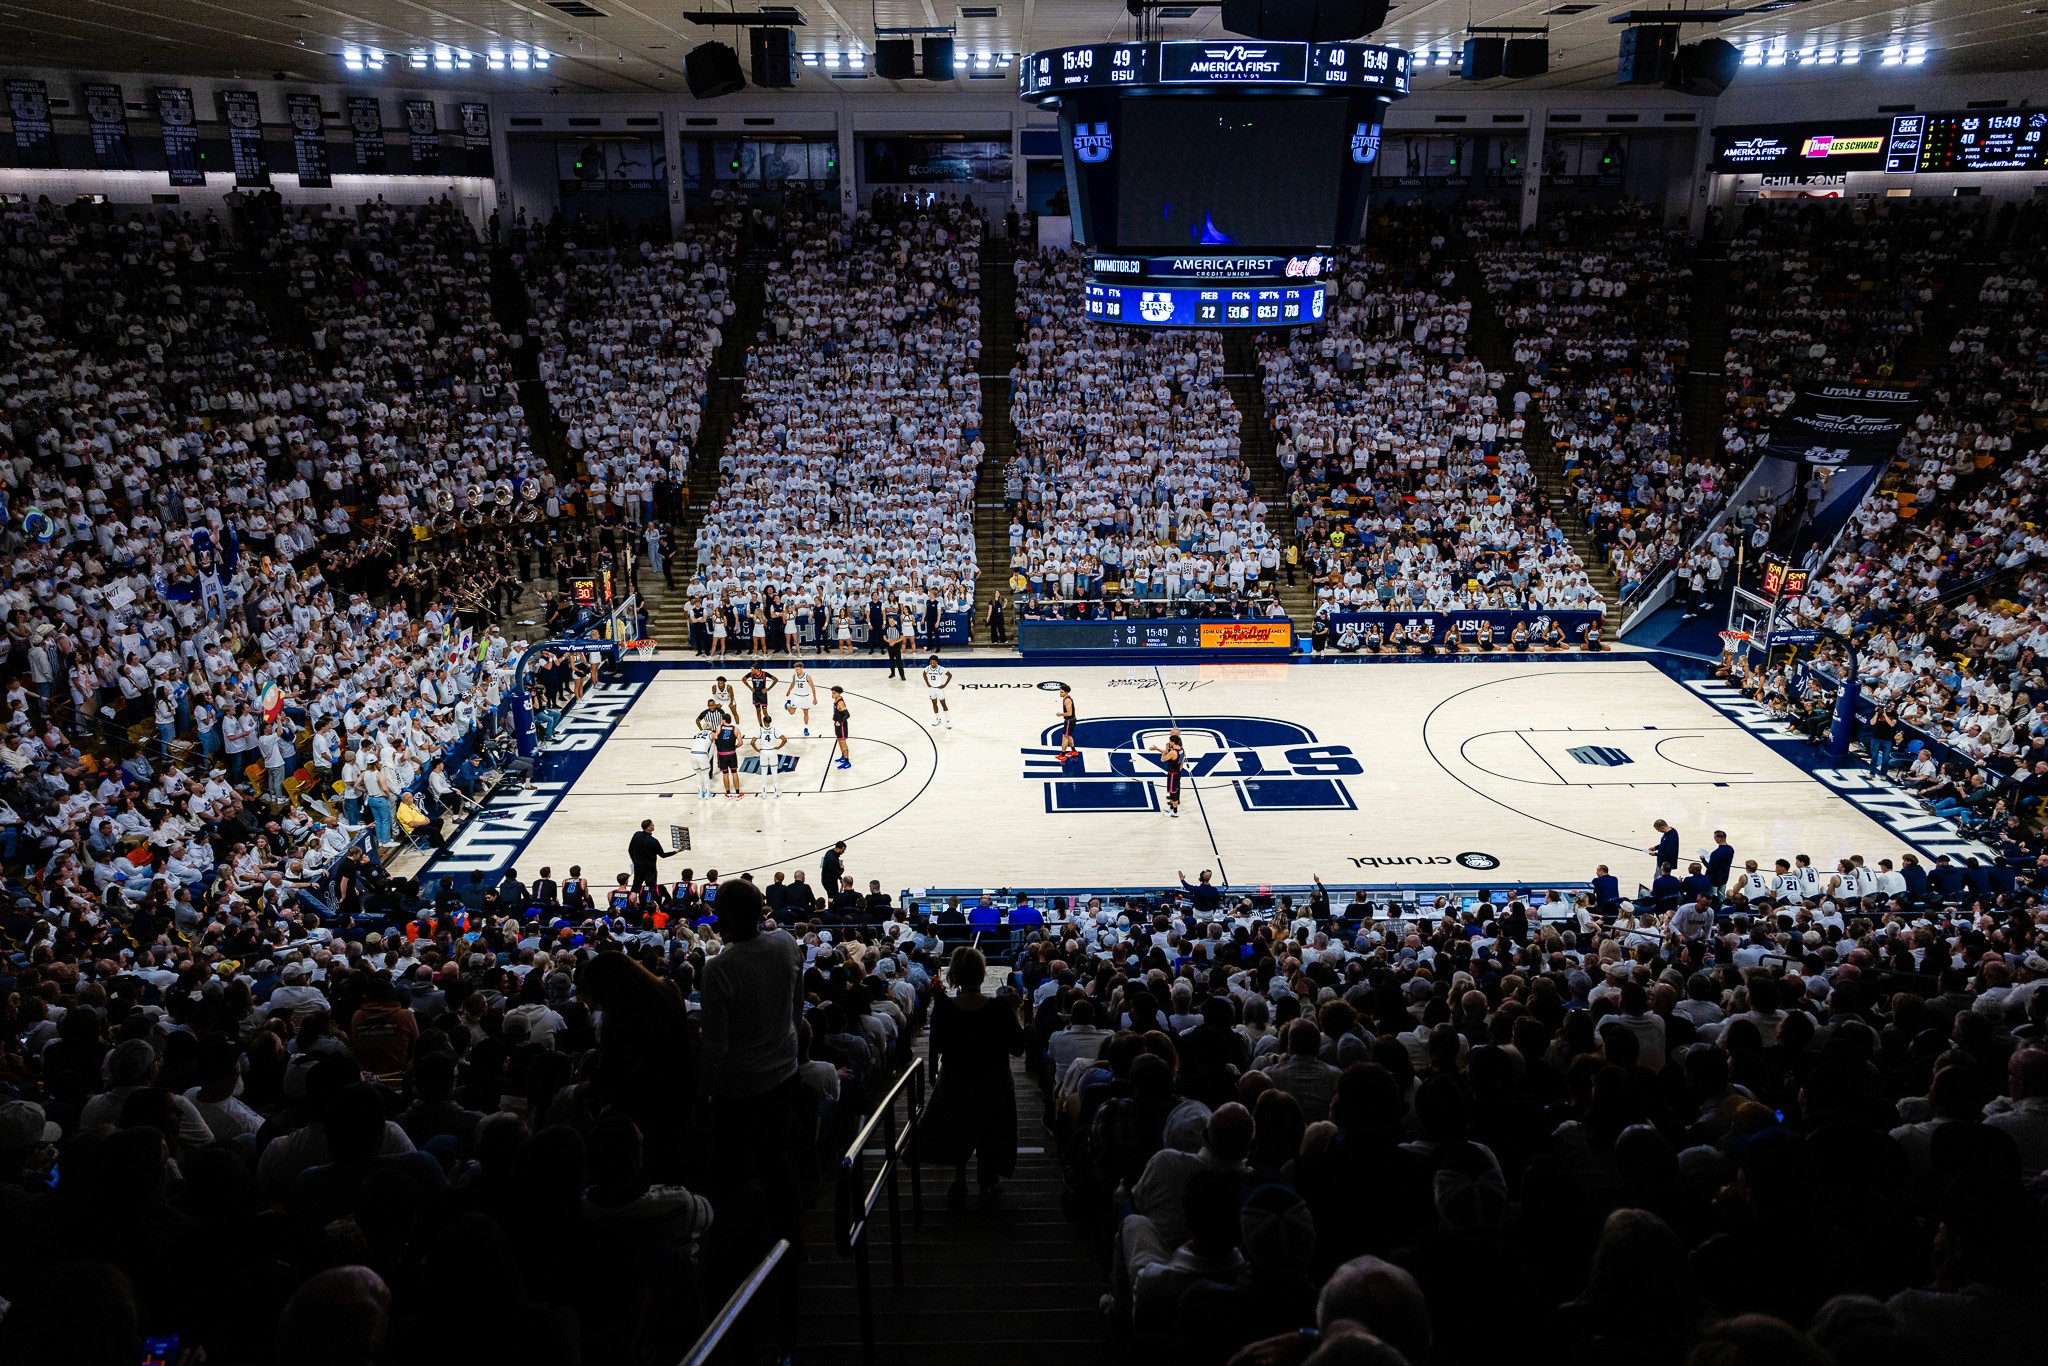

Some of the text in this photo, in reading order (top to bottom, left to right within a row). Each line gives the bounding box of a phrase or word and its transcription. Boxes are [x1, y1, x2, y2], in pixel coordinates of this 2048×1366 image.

[1062, 50, 1093, 70] 15:49
[1113, 50, 1131, 66] 49
[1330, 50, 1344, 66] 40
[1362, 50, 1388, 70] 15:49
[1040, 58, 1049, 74] 40
[1190, 62, 1280, 72] AMERICA FIRST
[1112, 70, 1134, 80] BSU
[1326, 70, 1348, 81] USU
[1038, 76, 1051, 87] USU
[1988, 116, 2022, 128] 15:49
[1074, 134, 1112, 150] STATE
[1960, 134, 1975, 144] 40
[2025, 132, 2040, 142] 49
[1351, 136, 1380, 150] STATE
[1811, 140, 1830, 152] Tires
[1831, 140, 1879, 150] LES SCHWAB
[1724, 148, 1788, 157] AMERICA FIRST
[1762, 175, 1846, 186] CHILL ZONE
[845, 190, 852, 198] K
[1094, 260, 1140, 274] MWMOTOR.CO
[1173, 259, 1274, 270] AMERICA FIRST
[1200, 292, 1218, 300] REB
[1232, 292, 1250, 300] FG%
[1258, 291, 1280, 300] 3PT%
[1286, 290, 1300, 299] FT%
[1822, 387, 1910, 400] UTAH STATE
[1793, 416, 1856, 430] AMERICA
[1804, 450, 1850, 460] STATE
[576, 580, 594, 588] 15:49
[1766, 572, 1779, 592] 30
[1788, 580, 1800, 590] 30
[106, 586, 119, 600] NOT
[578, 588, 590, 598] 30
[1146, 628, 1168, 637] 15:49
[1336, 622, 1364, 634] USU
[1126, 636, 1136, 645] 40
[1176, 636, 1187, 644] 49
[538, 682, 645, 752] STATE
[722, 730, 732, 740] 2
[1020, 744, 1364, 779] STATE
[1812, 768, 2004, 868] STATE
[427, 782, 568, 873] UTAH
[1346, 856, 1452, 868] crumbl
[1807, 873, 1815, 882] 8
[1866, 872, 1871, 882] 1
[1753, 879, 1761, 888] 5
[1786, 881, 1797, 890] 21
[1846, 880, 1854, 890] 2
[676, 888, 687, 898] 5
[704, 890, 716, 901] 13
